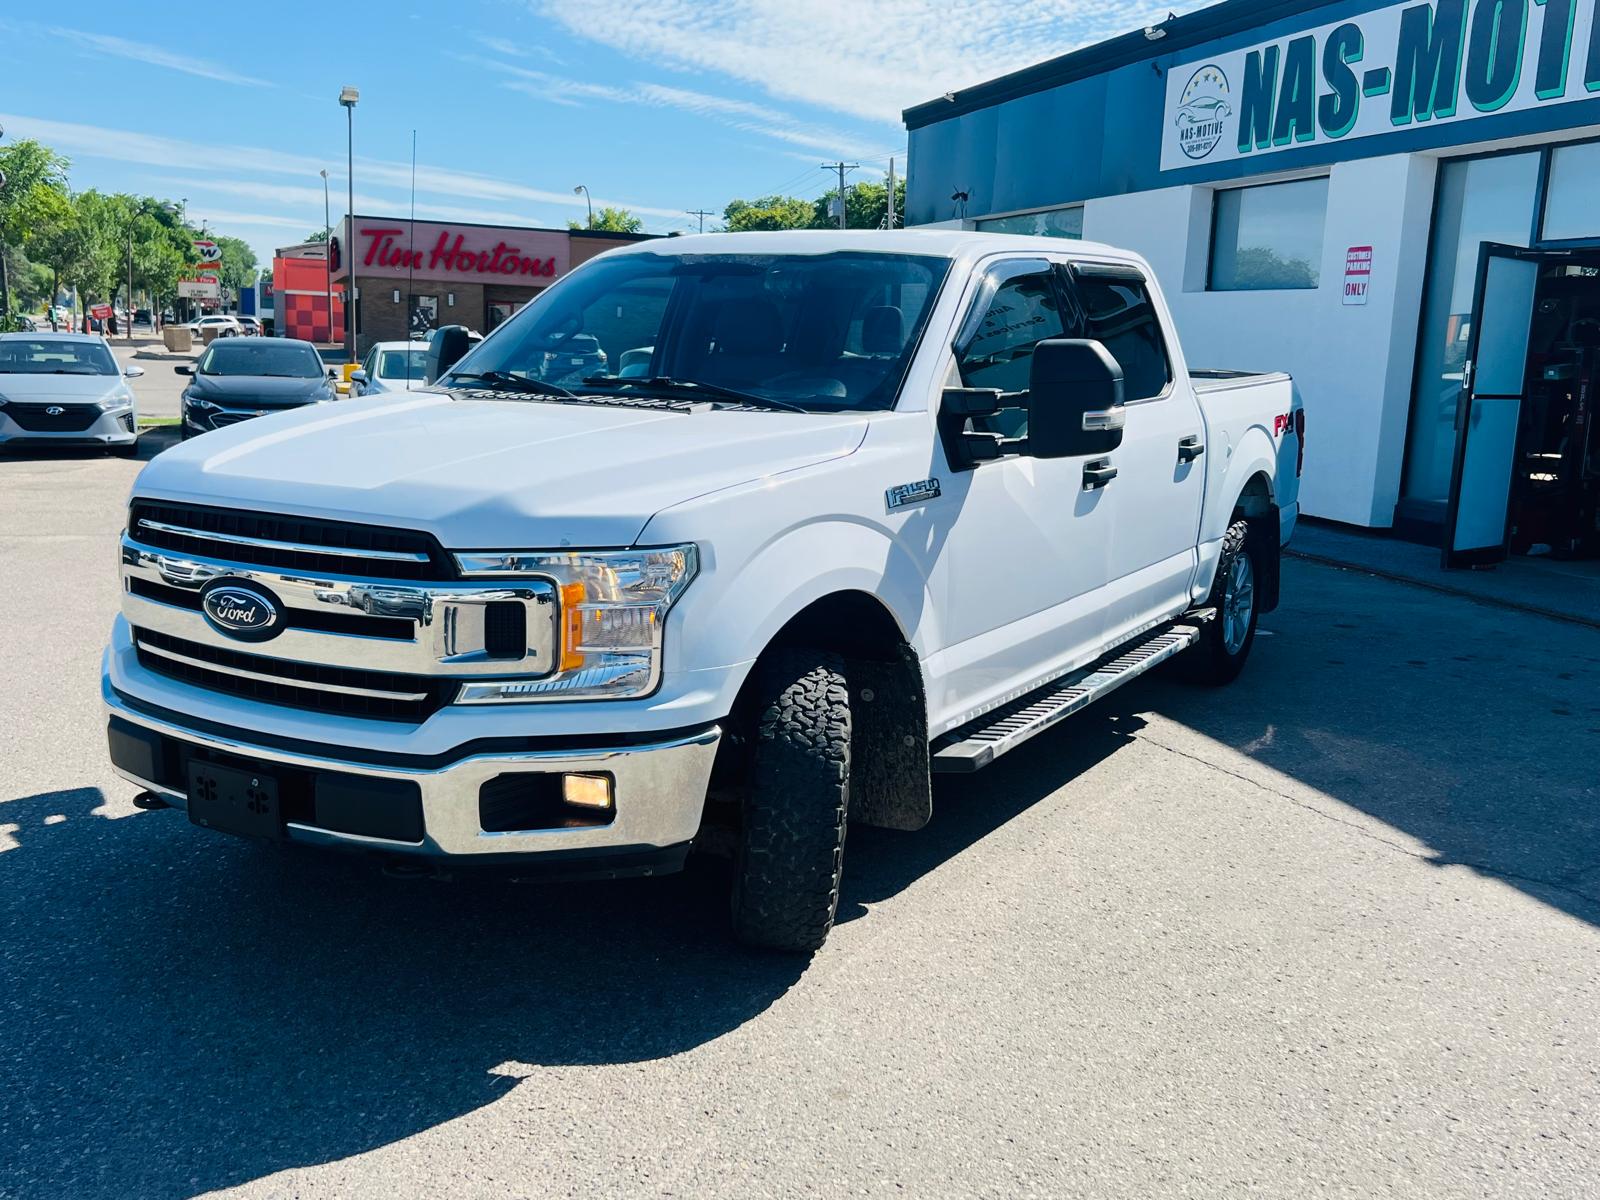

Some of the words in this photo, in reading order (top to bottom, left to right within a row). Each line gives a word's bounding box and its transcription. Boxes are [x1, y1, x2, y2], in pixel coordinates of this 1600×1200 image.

[1180, 121, 1223, 141] NAS-MOTIVE
[360, 229, 424, 269] Tim
[428, 230, 556, 277] Hortons
[1346, 261, 1371, 271] PARKING
[1345, 283, 1367, 296] ONLY
[217, 595, 256, 623] Ford
